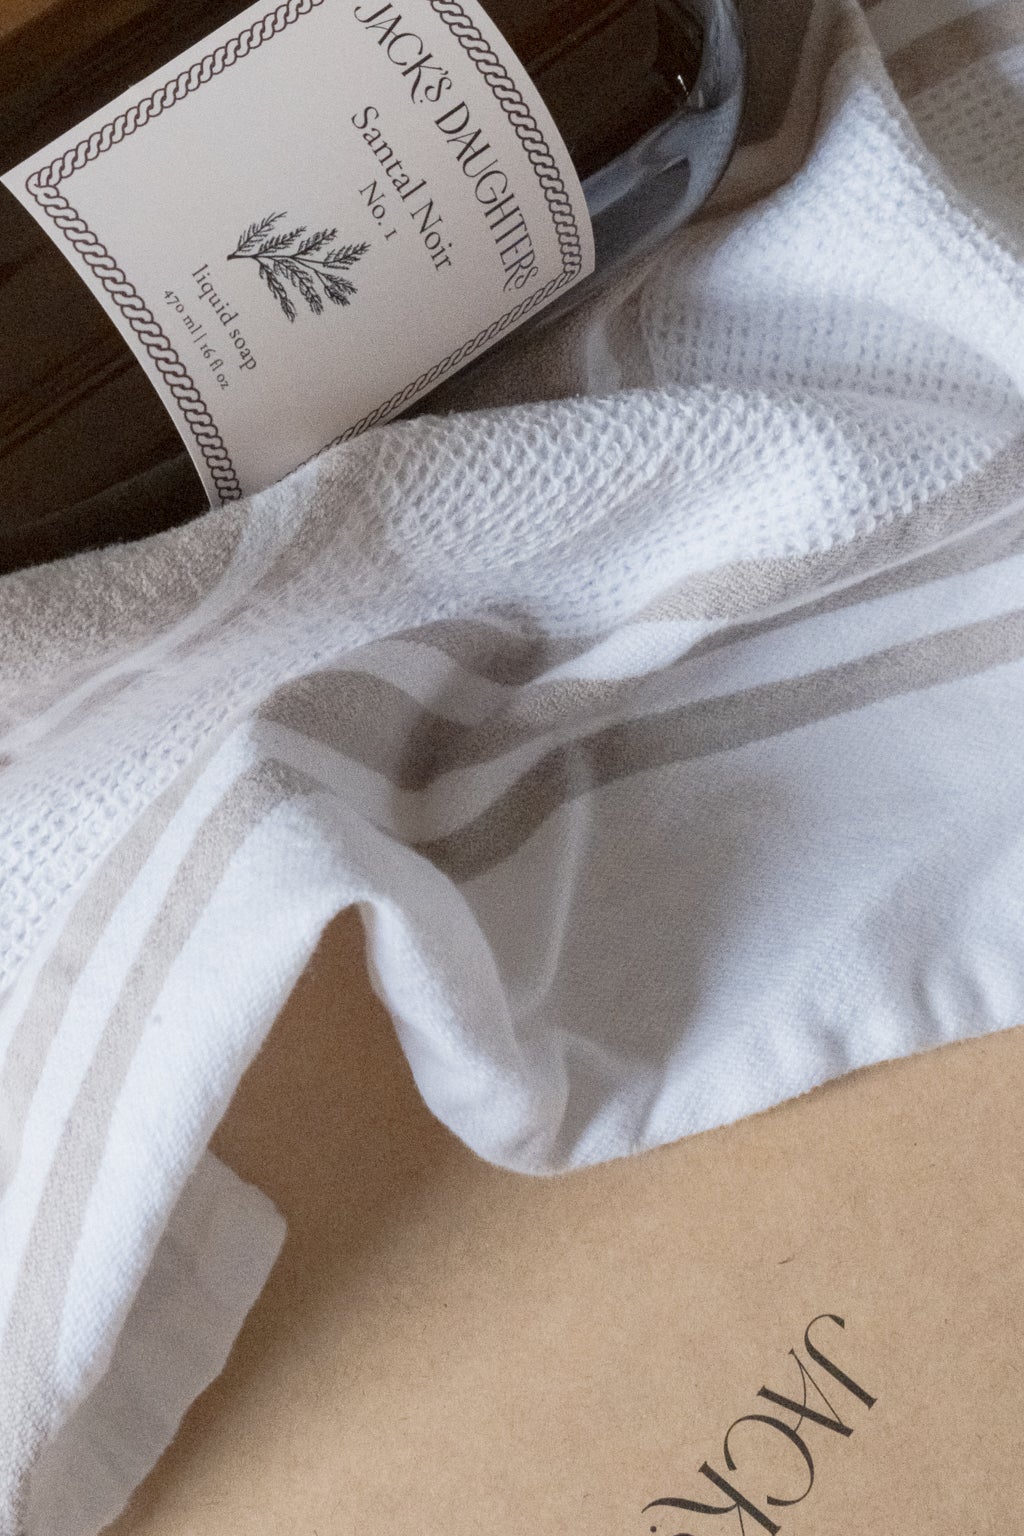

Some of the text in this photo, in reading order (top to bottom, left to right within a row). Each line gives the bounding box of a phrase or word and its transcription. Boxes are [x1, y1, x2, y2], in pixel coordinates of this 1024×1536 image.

[353, 2, 539, 293] JACK'S DAUGHTERS
[351, 105, 453, 272] Santal Noir
[358, 178, 386, 227] No.
[163, 289, 185, 314] 470
[182, 314, 203, 336] ml
[191, 263, 258, 372] liquid soap
[200, 343, 217, 360] 16
[209, 358, 225, 373] fl
[216, 372, 230, 391] oz
